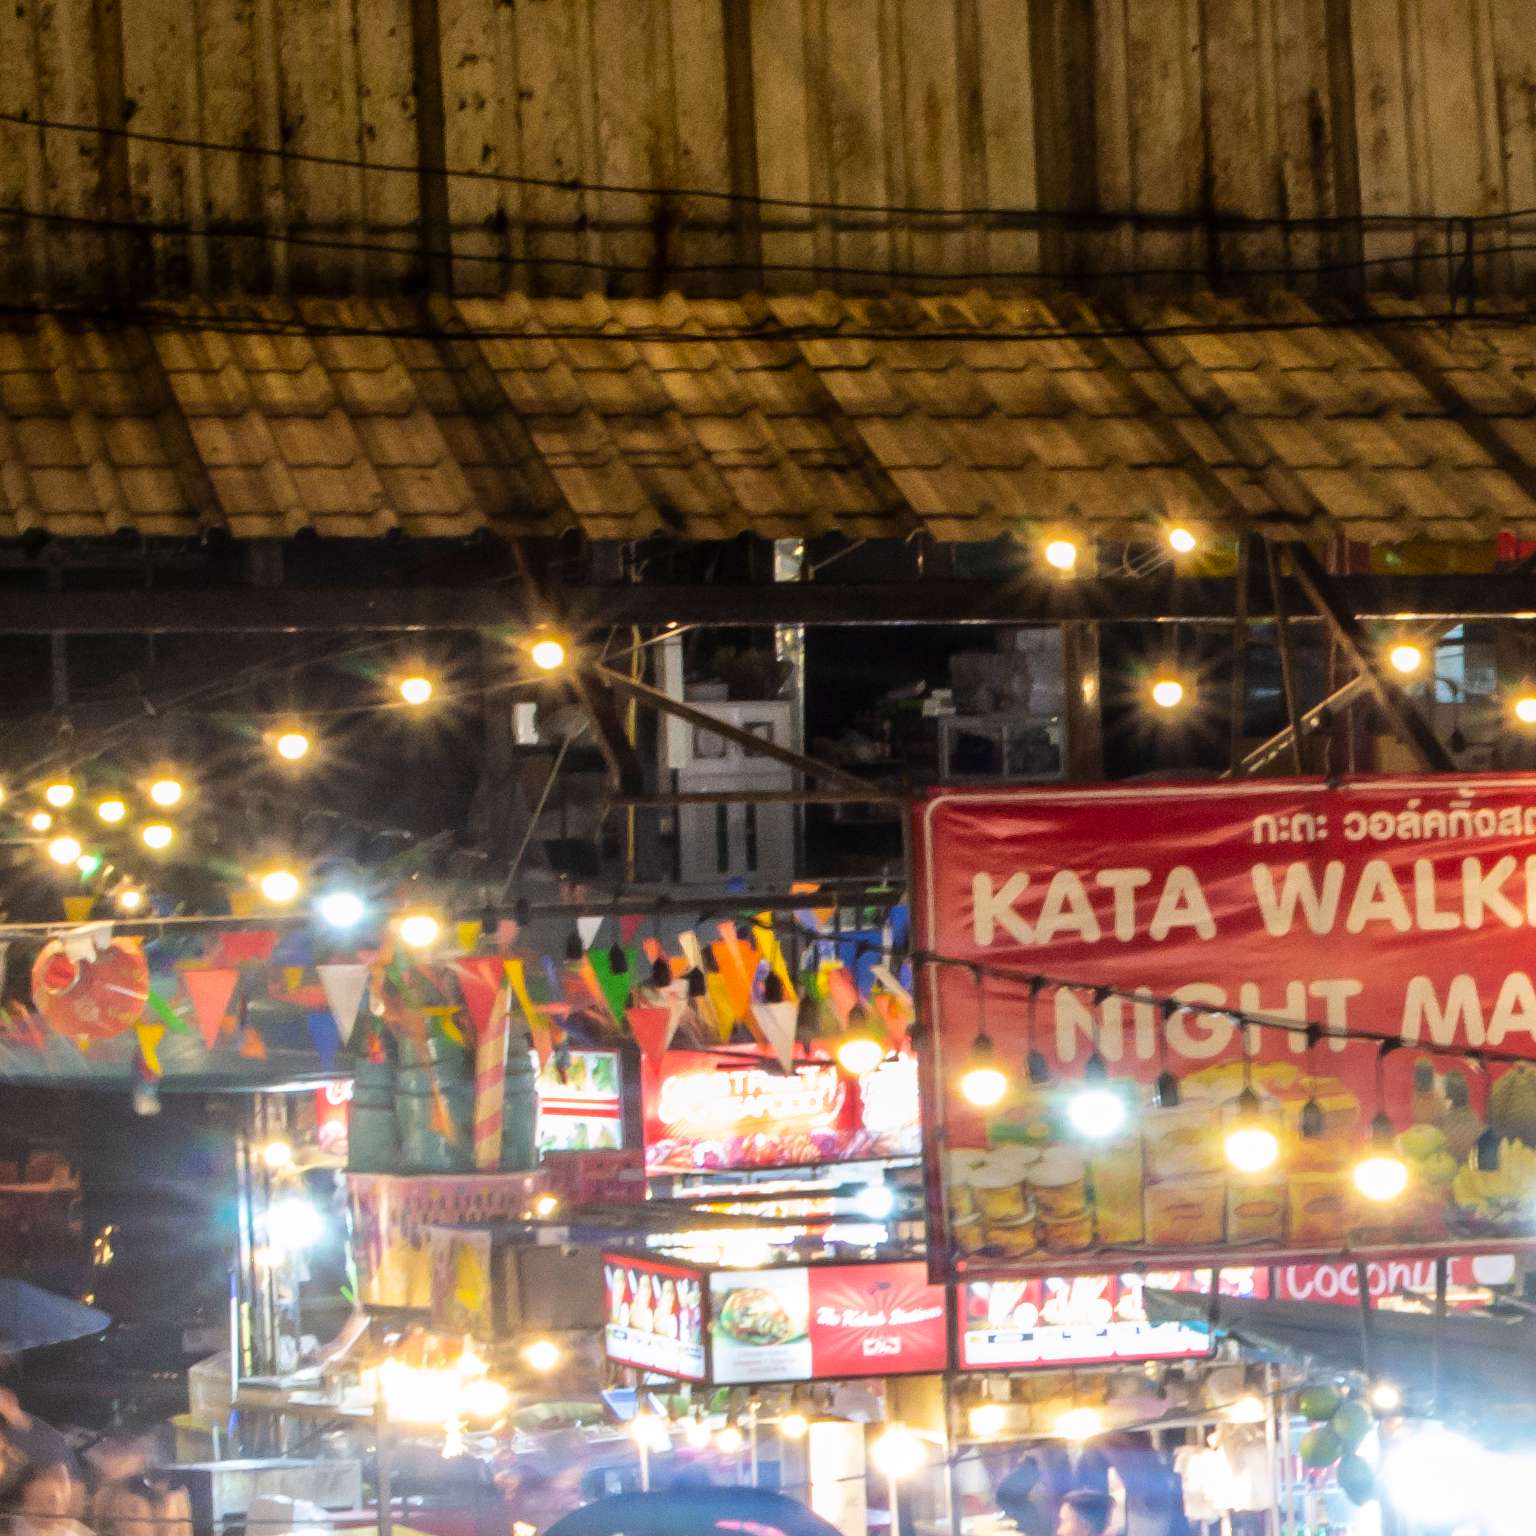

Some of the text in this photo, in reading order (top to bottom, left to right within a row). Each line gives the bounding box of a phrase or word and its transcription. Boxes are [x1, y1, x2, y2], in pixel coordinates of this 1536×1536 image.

[1253, 811, 1328, 845] กะตะ
[971, 864, 1217, 947] KATA
[1053, 979, 1364, 1063] NIGHT
